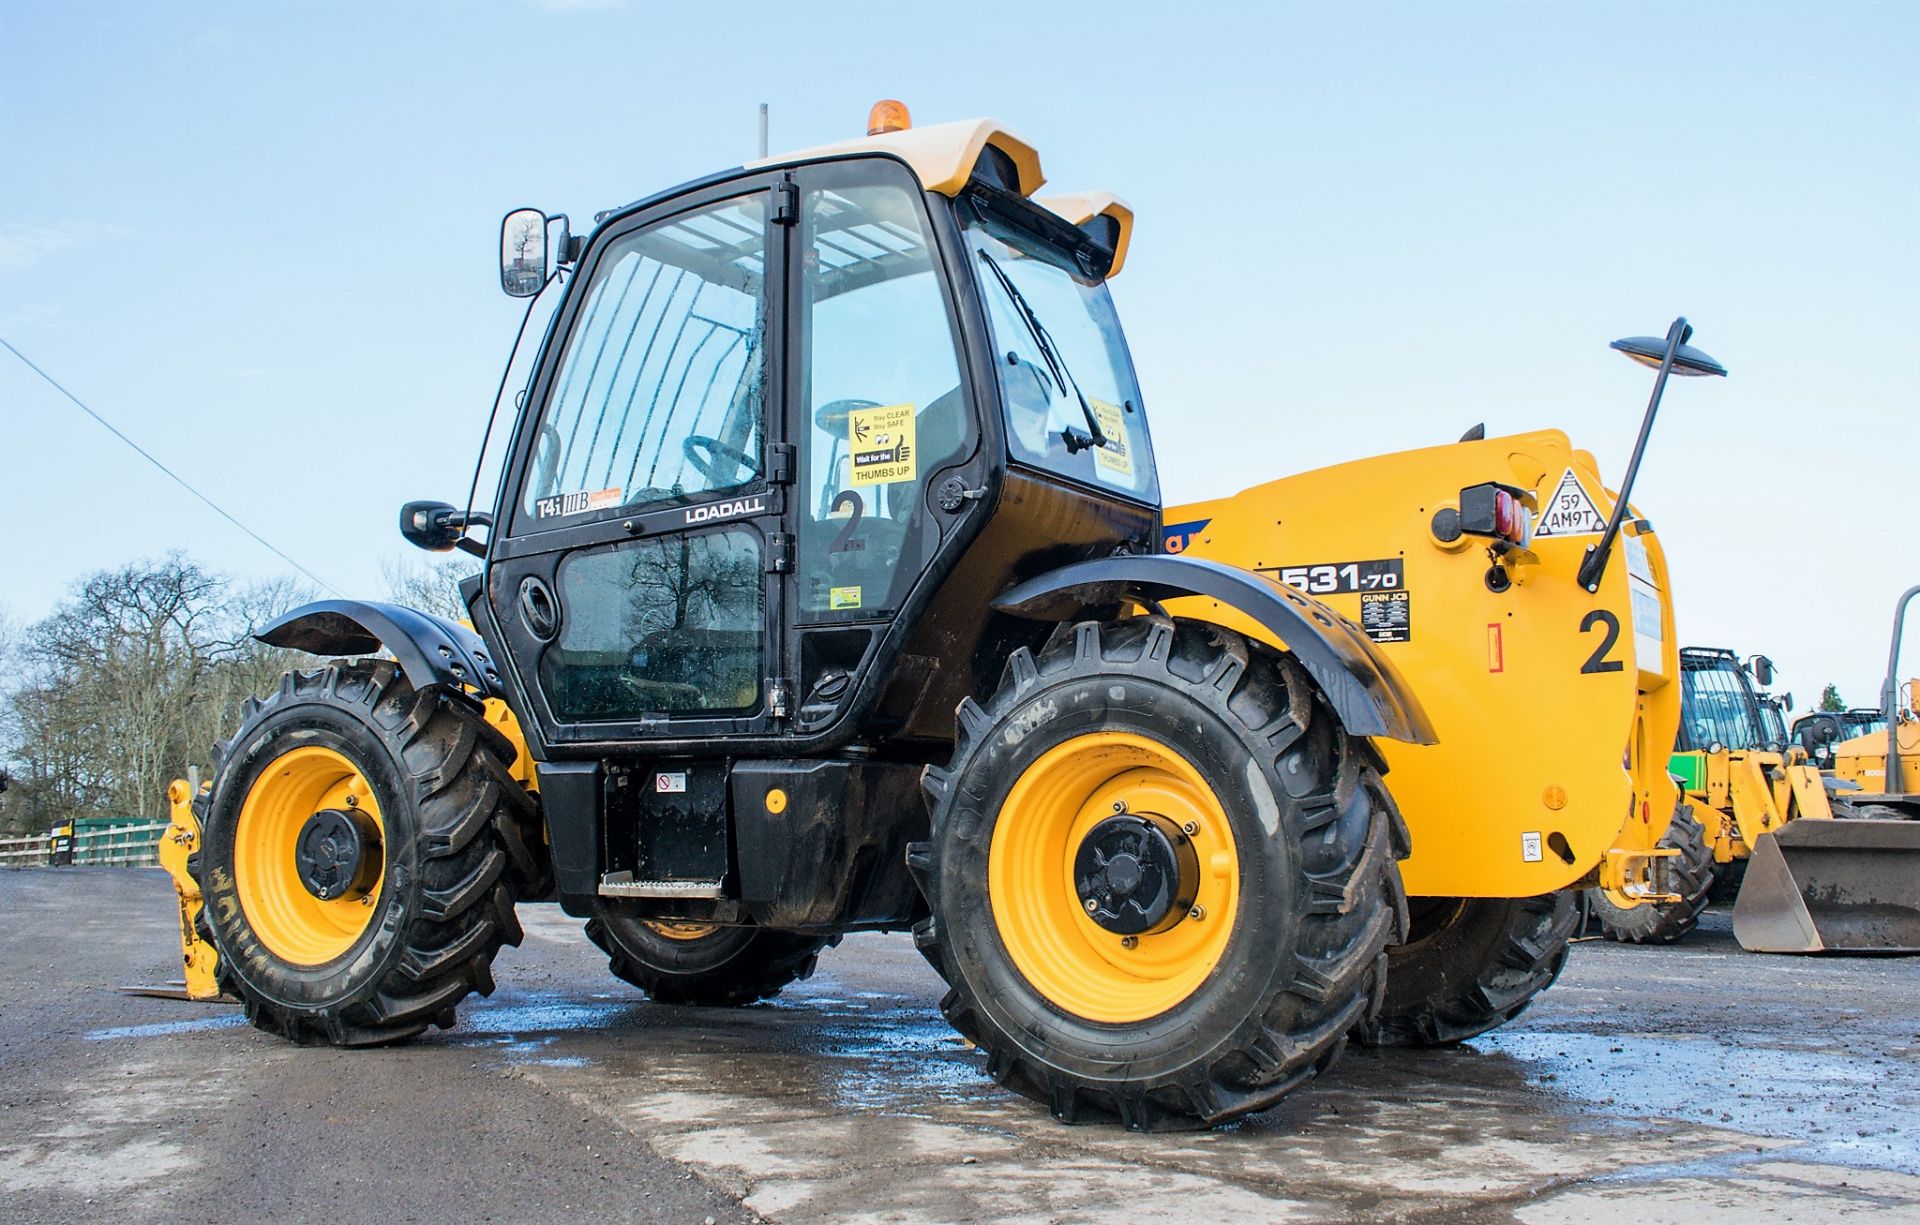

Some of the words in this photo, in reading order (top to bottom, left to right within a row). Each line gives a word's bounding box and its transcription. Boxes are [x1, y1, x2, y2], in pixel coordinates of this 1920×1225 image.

[886, 410, 910, 420] CLEAR
[887, 420, 905, 428] SAFE
[856, 455, 869, 464] Wait
[870, 453, 880, 462] for
[880, 453, 891, 461] the
[856, 468, 895, 480] THUMBS
[897, 466, 910, 475] UP
[537, 497, 561, 518] T4i
[685, 498, 766, 524] LOADALL
[1561, 494, 1580, 511] 59
[830, 490, 865, 553] 2
[1551, 510, 1592, 528] AM9T
[1362, 593, 1389, 603] GUNN
[1390, 592, 1408, 601] JCB
[1579, 609, 1624, 675] 2
